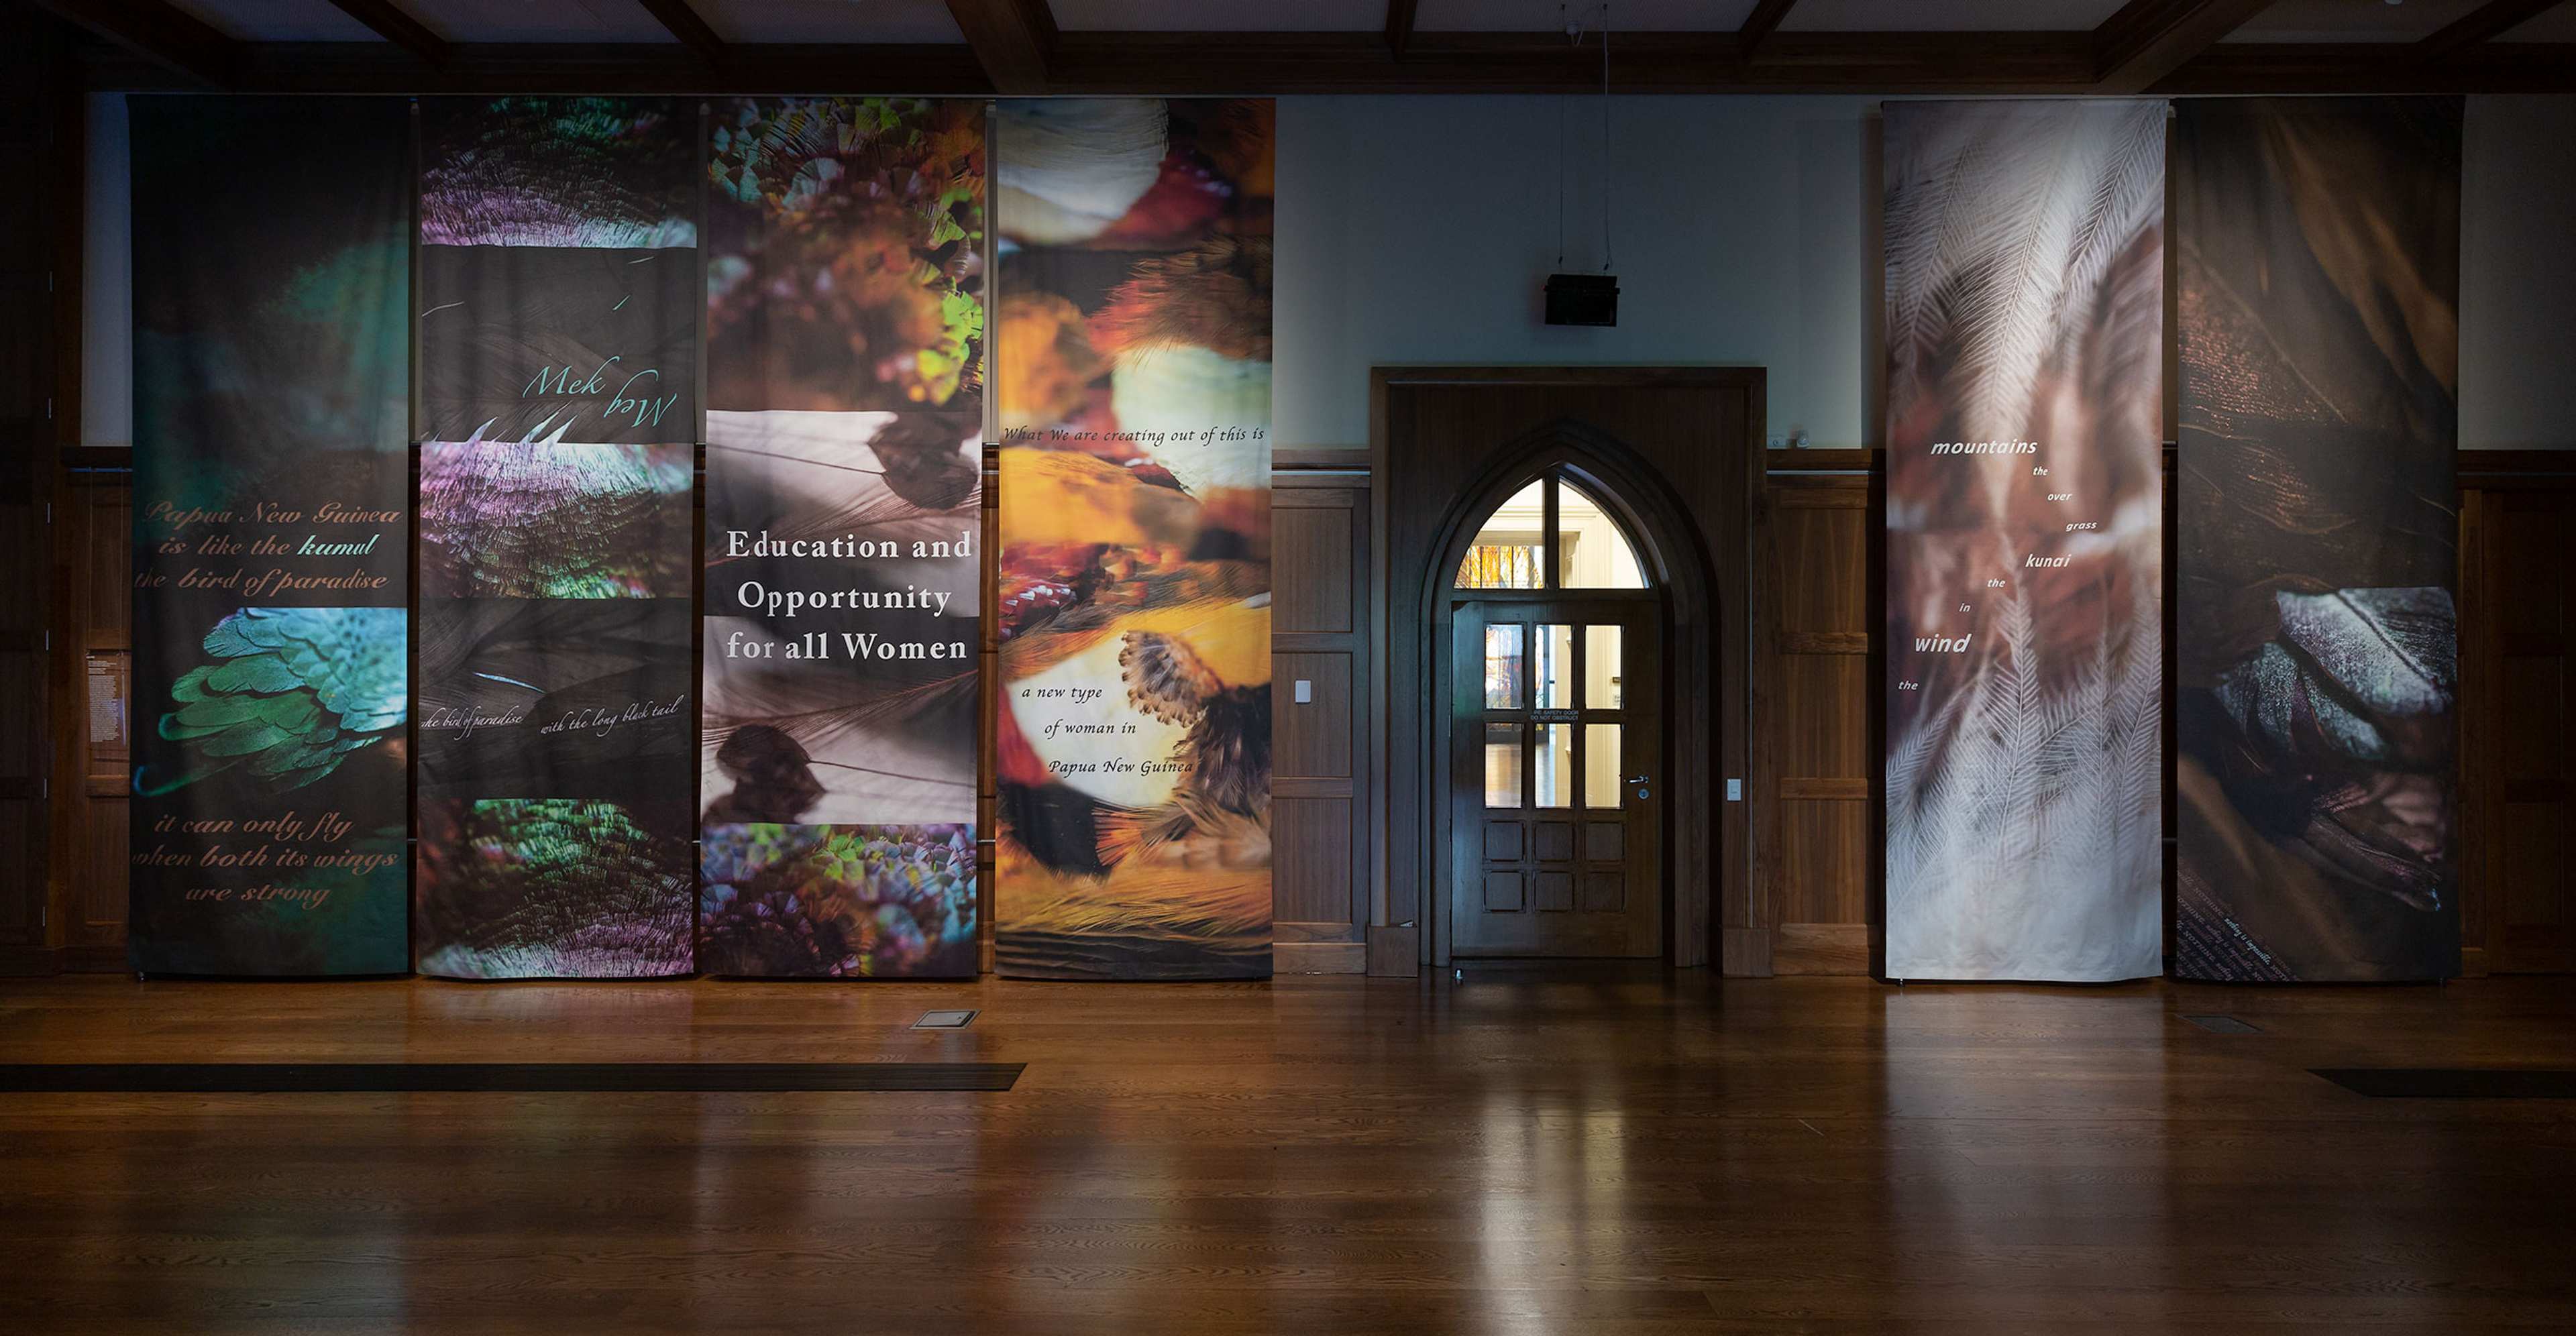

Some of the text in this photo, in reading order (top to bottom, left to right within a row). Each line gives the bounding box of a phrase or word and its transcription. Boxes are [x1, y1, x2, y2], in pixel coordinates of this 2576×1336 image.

[523, 356, 619, 398] Mek
[1004, 425, 1265, 447] What We are creating out of this is
[1931, 439, 2038, 455] mountains
[2033, 466, 2048, 476] the
[2047, 492, 2073, 502] over
[146, 500, 402, 530] Papua New Guinea
[2065, 520, 2098, 532] grass
[158, 534, 380, 555] is like the kumul
[727, 531, 972, 558] Education and
[2025, 554, 2072, 568] kunai
[135, 567, 390, 597] the bird of paradise
[1987, 578, 2006, 588] the
[737, 581, 952, 617] Opportunity
[1959, 603, 1971, 612] in
[727, 632, 967, 660] for all Women
[1915, 634, 1972, 653] wind
[1022, 686, 1103, 704] a new type
[1898, 681, 1919, 691] the
[443, 708, 468, 728] bird
[453, 706, 482, 740] of
[466, 706, 523, 737] paradise
[541, 695, 684, 737] with the long black tail
[1044, 719, 1136, 739] of woman in
[1049, 757, 1193, 778] Papua New Guinea
[153, 811, 356, 843] it can only fly
[131, 844, 400, 876] when both its wings
[185, 884, 333, 910] are strong
